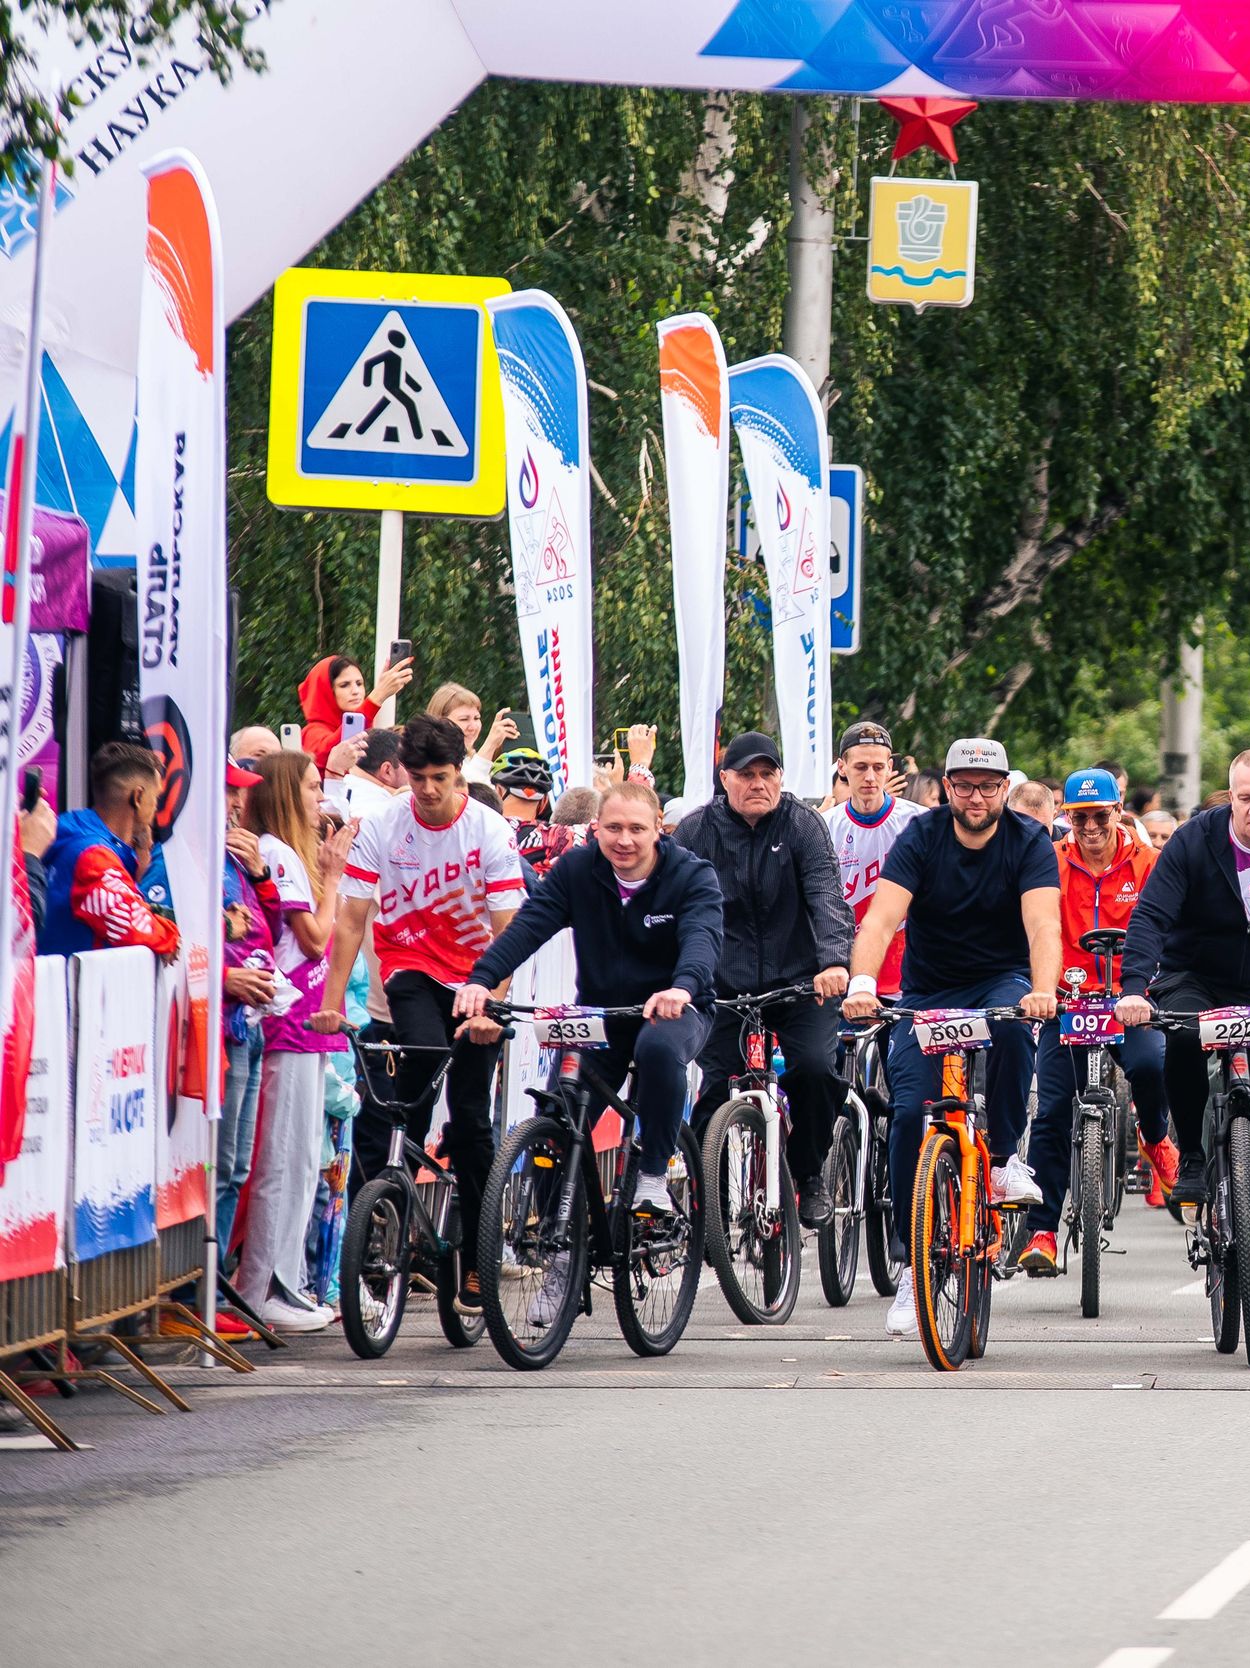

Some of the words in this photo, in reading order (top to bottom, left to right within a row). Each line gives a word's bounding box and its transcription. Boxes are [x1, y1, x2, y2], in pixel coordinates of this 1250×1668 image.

[78, 59, 203, 177] НАУКА
[380, 848, 481, 915] СУДЬЯ
[547, 1022, 591, 1039] 333
[931, 1023, 973, 1041] 500
[1071, 1014, 1112, 1032] 097
